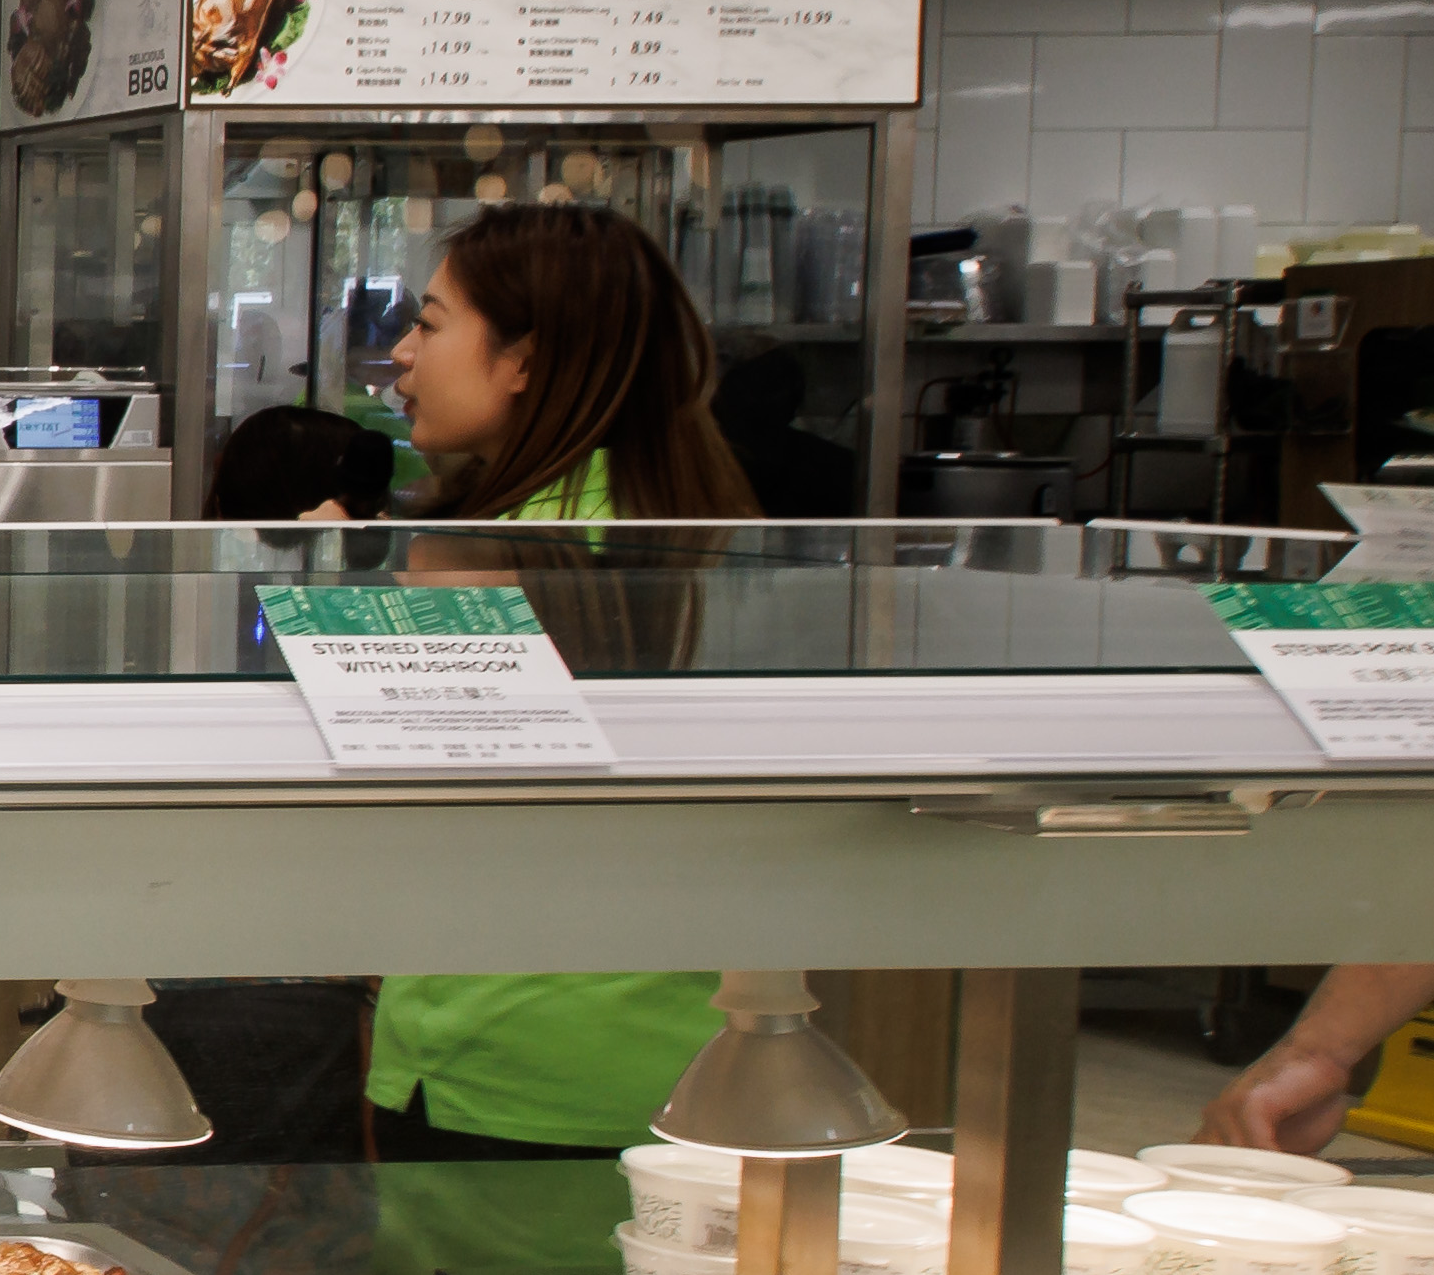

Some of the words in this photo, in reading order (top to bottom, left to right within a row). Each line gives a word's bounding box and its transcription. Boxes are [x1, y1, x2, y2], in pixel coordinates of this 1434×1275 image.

[128, 64, 169, 98] BBQ
[312, 642, 357, 656] STIR
[362, 642, 419, 656] FRIED
[425, 641, 528, 655] BROCCOLI
[337, 660, 395, 673] WITH
[398, 660, 522, 673] MUSHROOM
